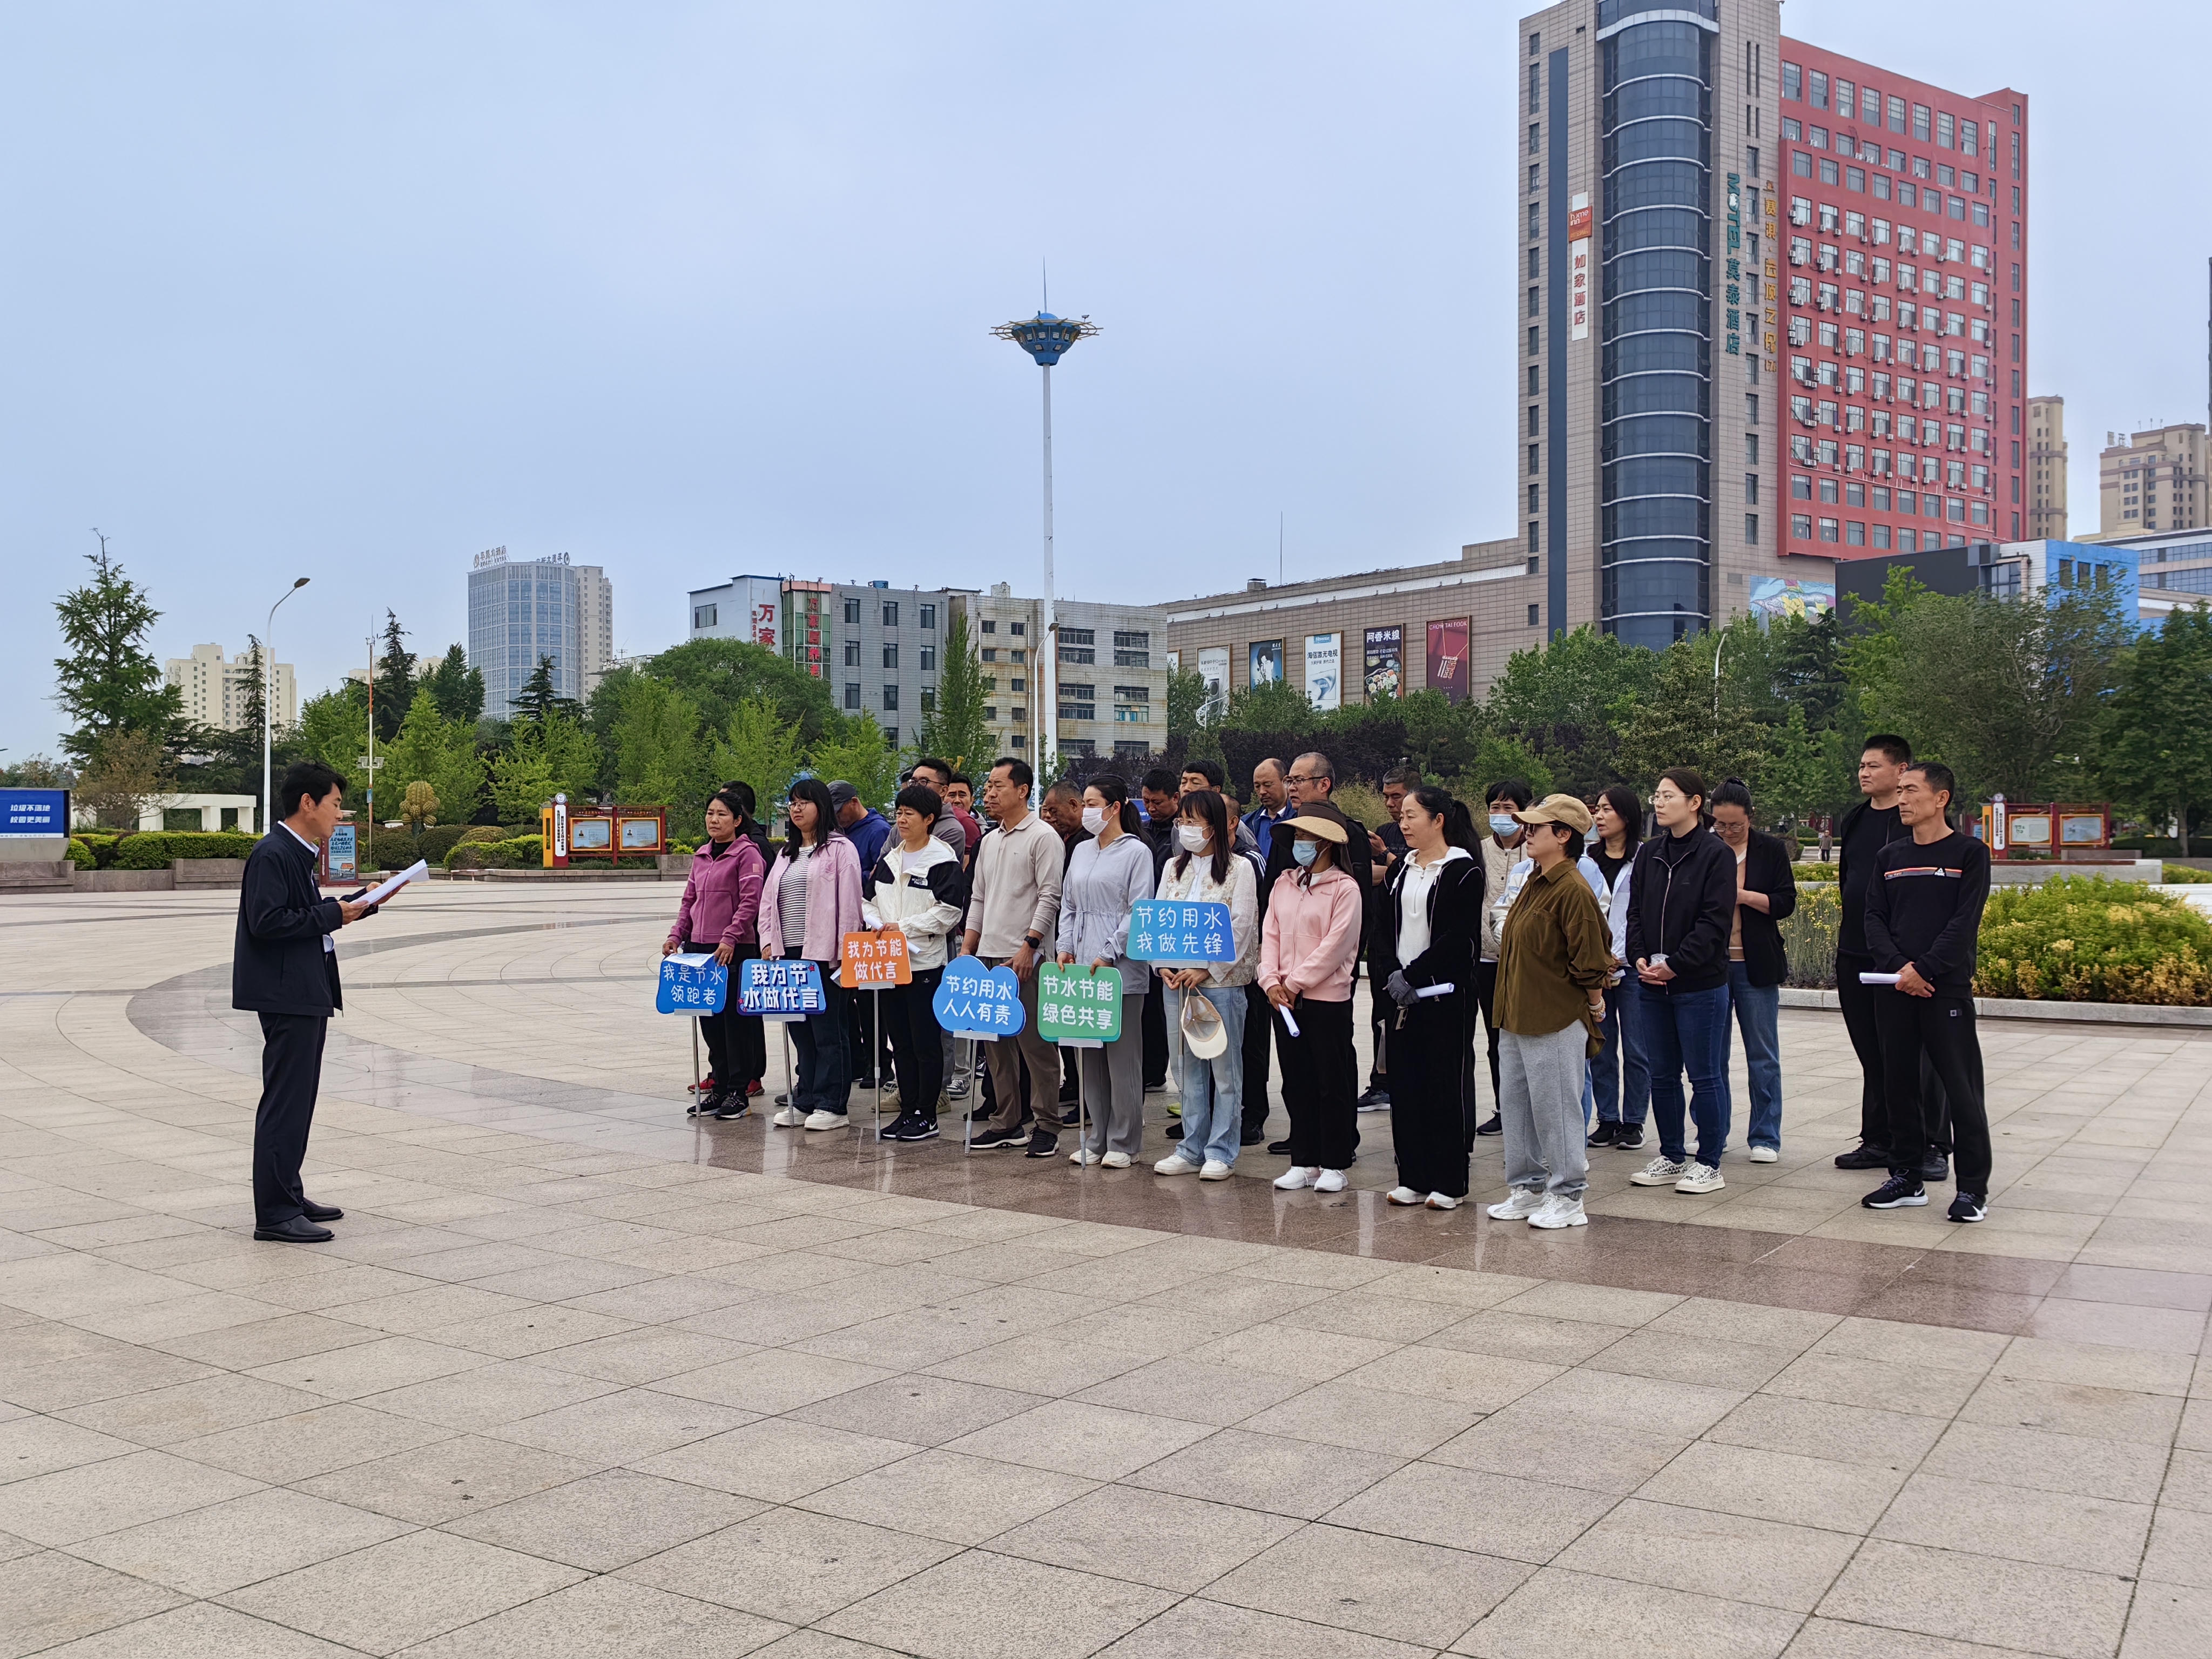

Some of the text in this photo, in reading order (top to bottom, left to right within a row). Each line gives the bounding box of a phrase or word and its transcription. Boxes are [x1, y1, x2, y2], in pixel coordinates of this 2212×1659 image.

[1727, 172, 1741, 254] MOTEL
[1574, 254, 1586, 326] 如家酒店
[1726, 258, 1741, 356] 莫泰酒店
[758, 604, 776, 656] 万家
[1136, 906, 1223, 929] 节约用水
[848, 938, 902, 959] 我为节能
[1136, 931, 1223, 956] 我做先锋
[663, 963, 724, 986] 我是节水
[751, 963, 808, 986] 我为节
[854, 961, 898, 981] 做代言
[670, 985, 717, 1006] 领跑者
[743, 987, 819, 1009] 水做代言
[945, 975, 1013, 1001] 节约用水
[1042, 975, 1114, 1002] 节水节能
[942, 1000, 1013, 1026] 人人有责
[1042, 1002, 1114, 1030] 绿色共享
